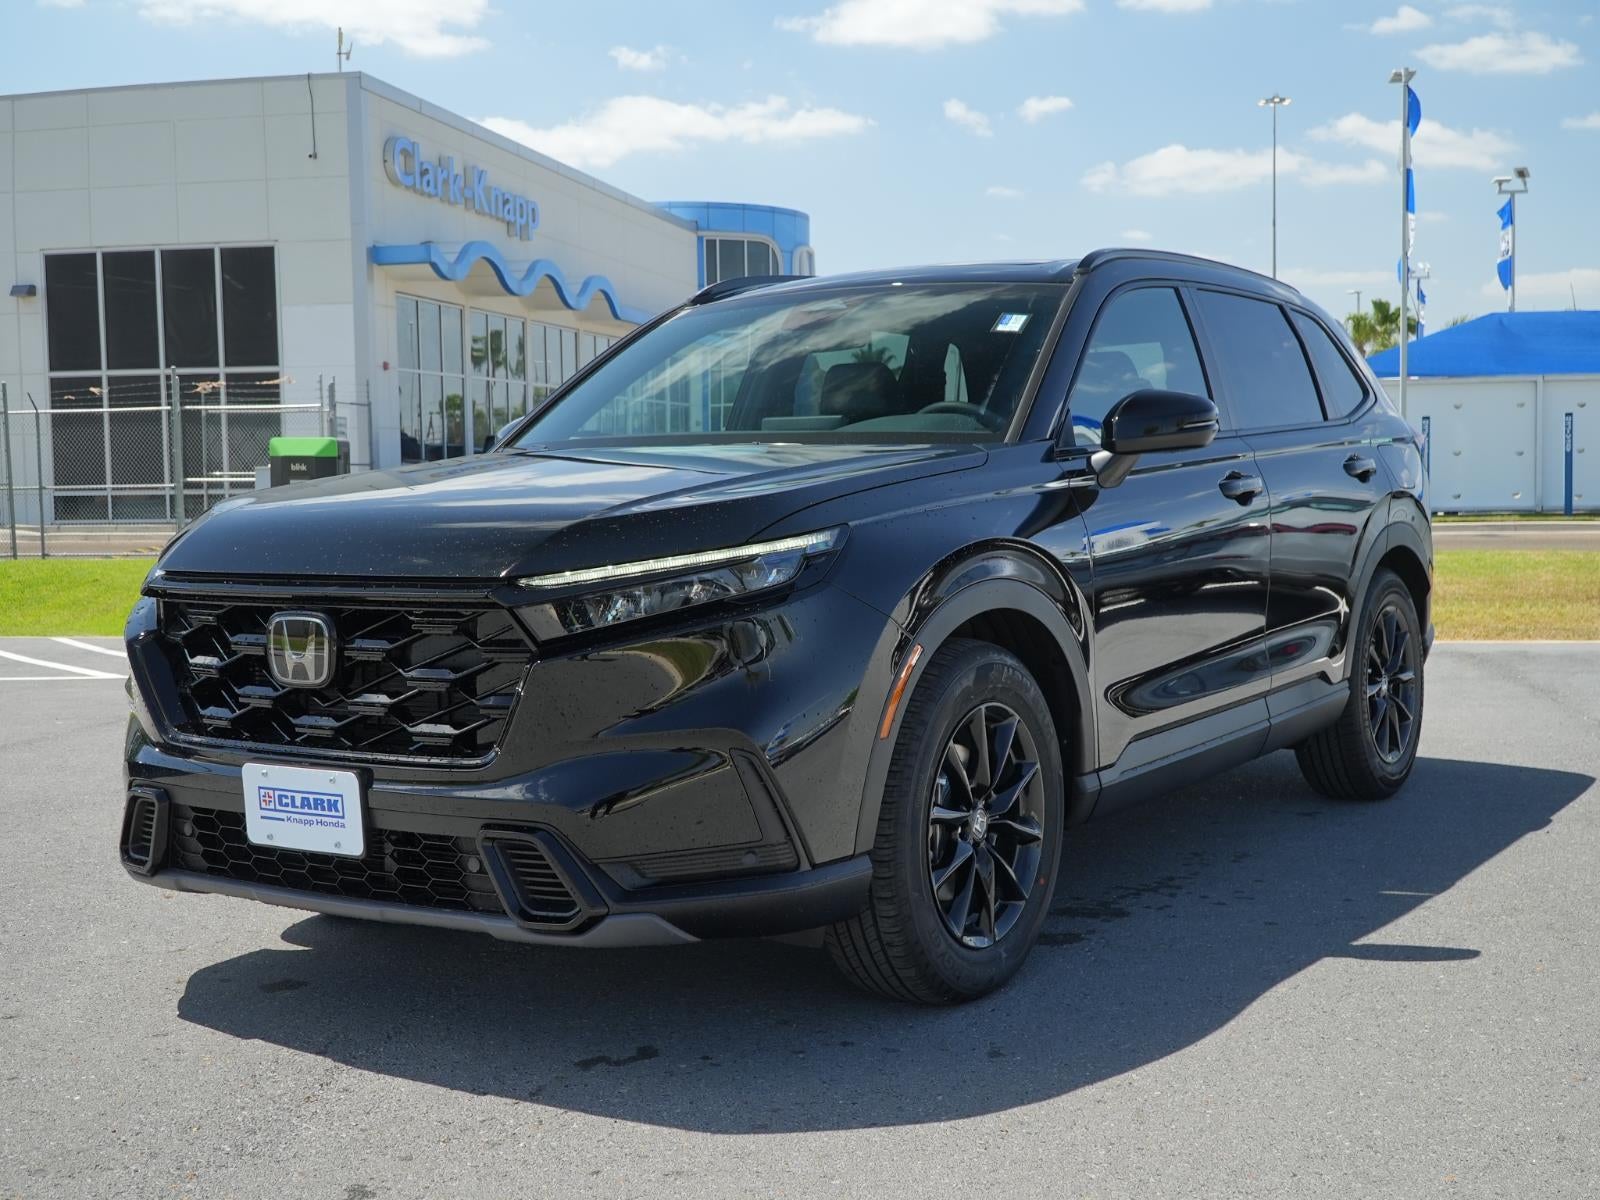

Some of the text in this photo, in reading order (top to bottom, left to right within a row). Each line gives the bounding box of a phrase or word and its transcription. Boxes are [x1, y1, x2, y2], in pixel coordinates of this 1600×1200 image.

[385, 136, 540, 241] Clark-Knapp
[290, 463, 307, 471] blink
[277, 793, 340, 813] CLARK
[286, 815, 346, 829] Knapp Honda
